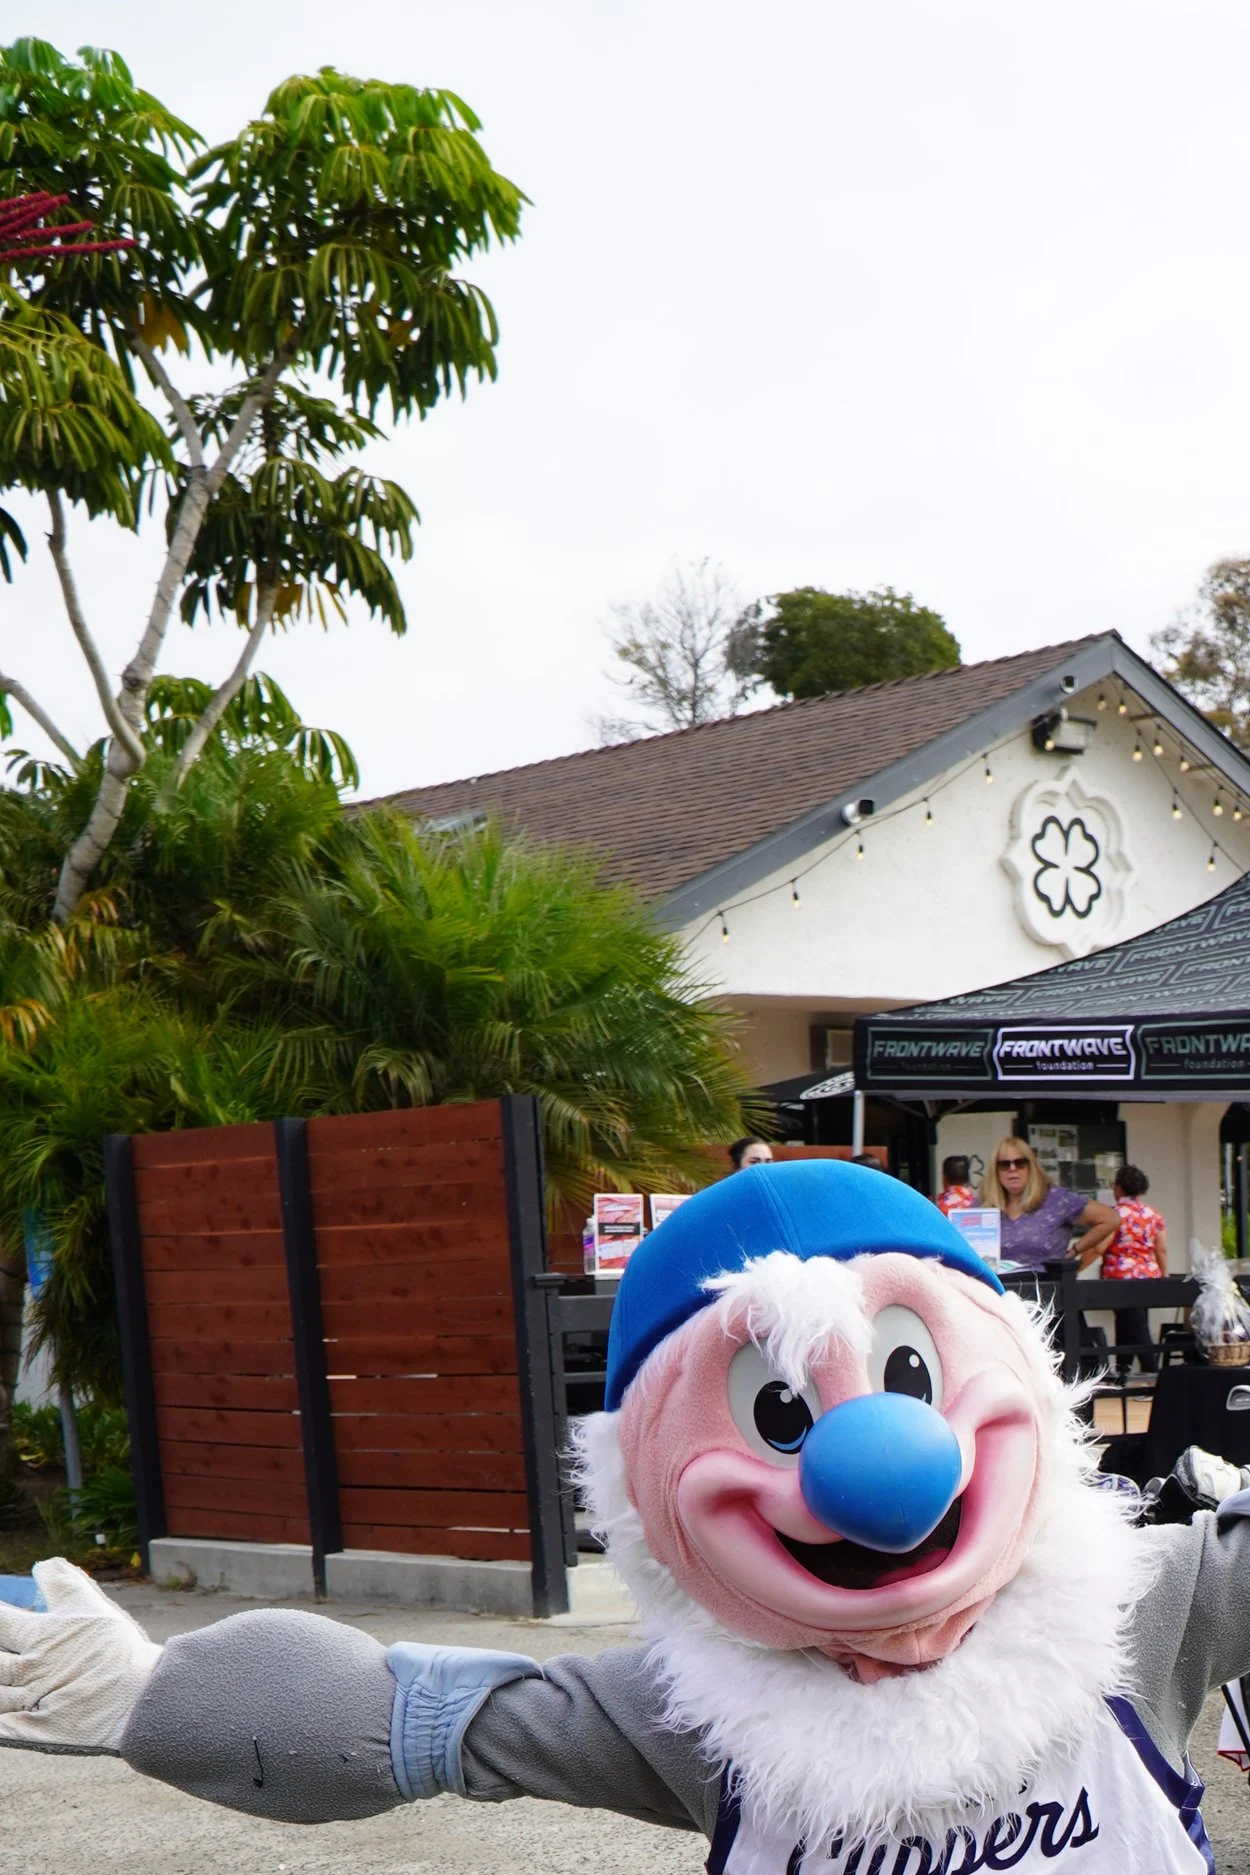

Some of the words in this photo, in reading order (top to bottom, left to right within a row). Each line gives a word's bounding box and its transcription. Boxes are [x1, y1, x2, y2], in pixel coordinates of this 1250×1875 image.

[872, 1040, 986, 1059] FRONTWAVE
[999, 1038, 1128, 1059] FRONTWAVE
[1034, 1059, 1095, 1072] foundation
